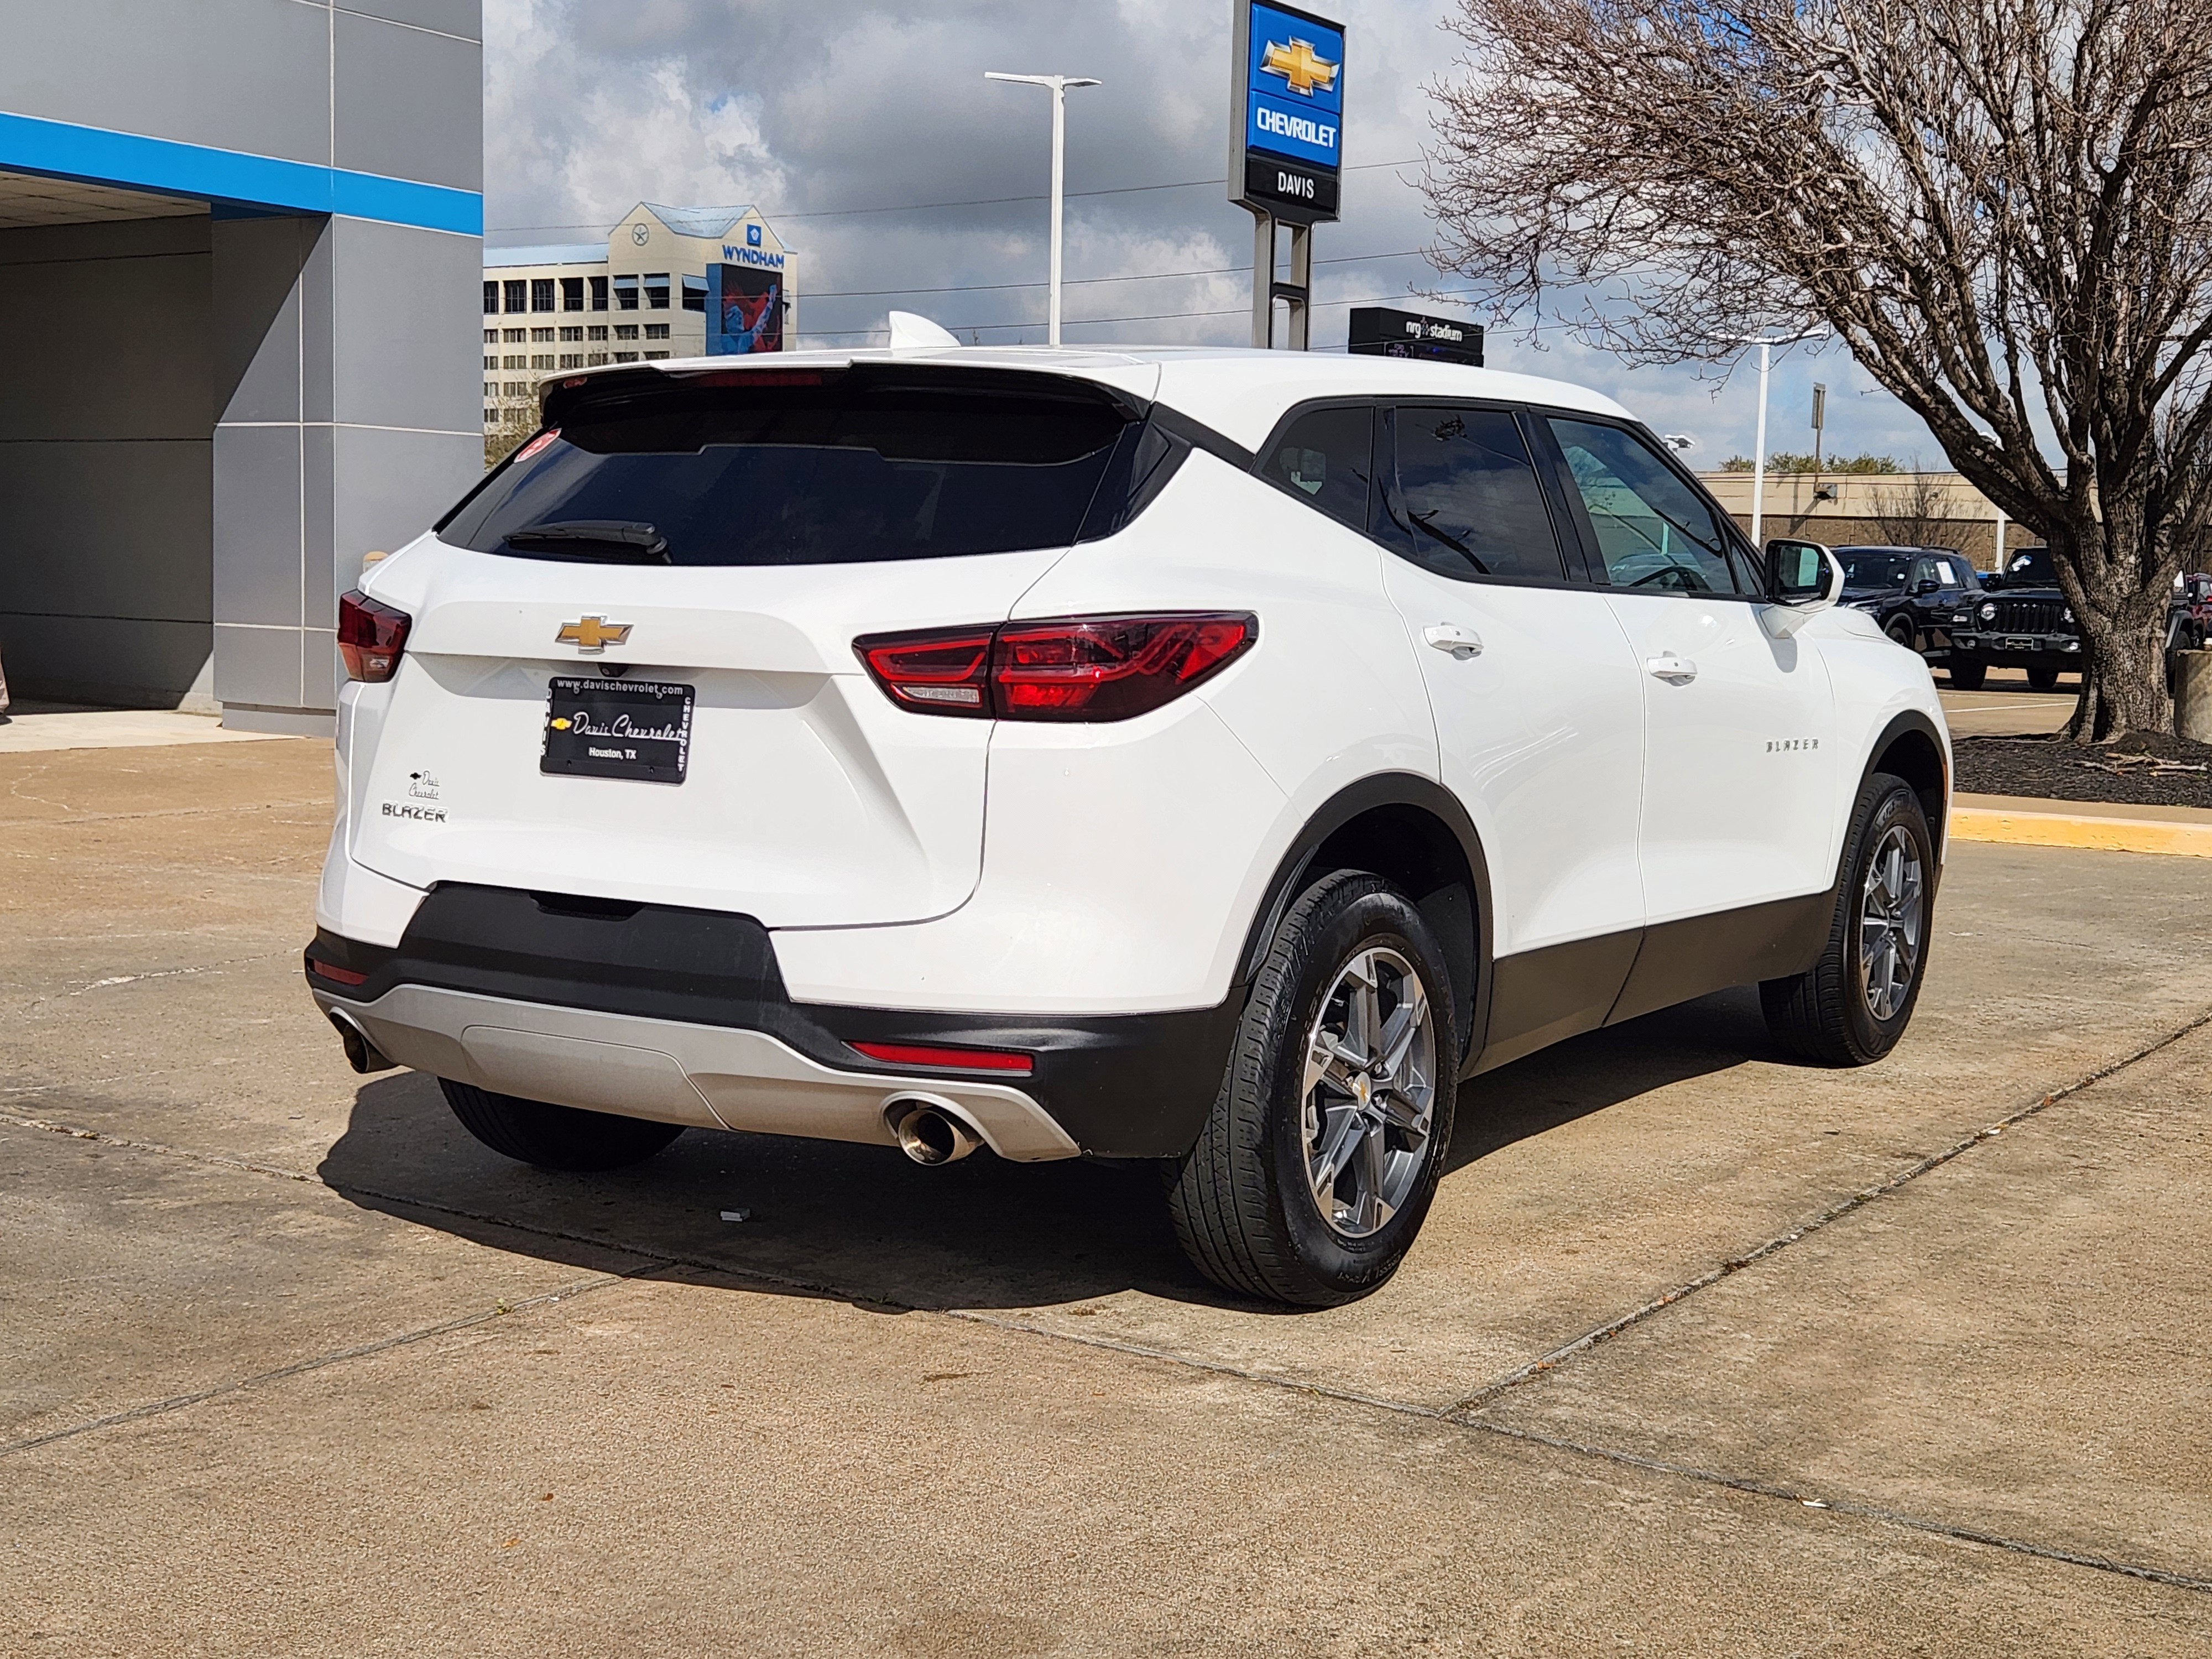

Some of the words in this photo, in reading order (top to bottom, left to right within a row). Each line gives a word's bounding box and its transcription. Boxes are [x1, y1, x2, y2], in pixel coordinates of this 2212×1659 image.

[1257, 107, 1337, 148] CHEVROLET
[1278, 171, 1314, 199] DAVIS
[722, 244, 784, 269] WYNDHAM
[1406, 321, 1421, 339] nrg
[1430, 324, 1463, 342] stadium
[573, 711, 611, 734] Davis
[612, 714, 682, 741] Chevrolet
[677, 697, 691, 771] CHEVROLET
[588, 747, 623, 760] Houston,
[625, 749, 637, 759] TX
[1766, 739, 1818, 753] BLAZER
[382, 802, 447, 823] BLAZER
